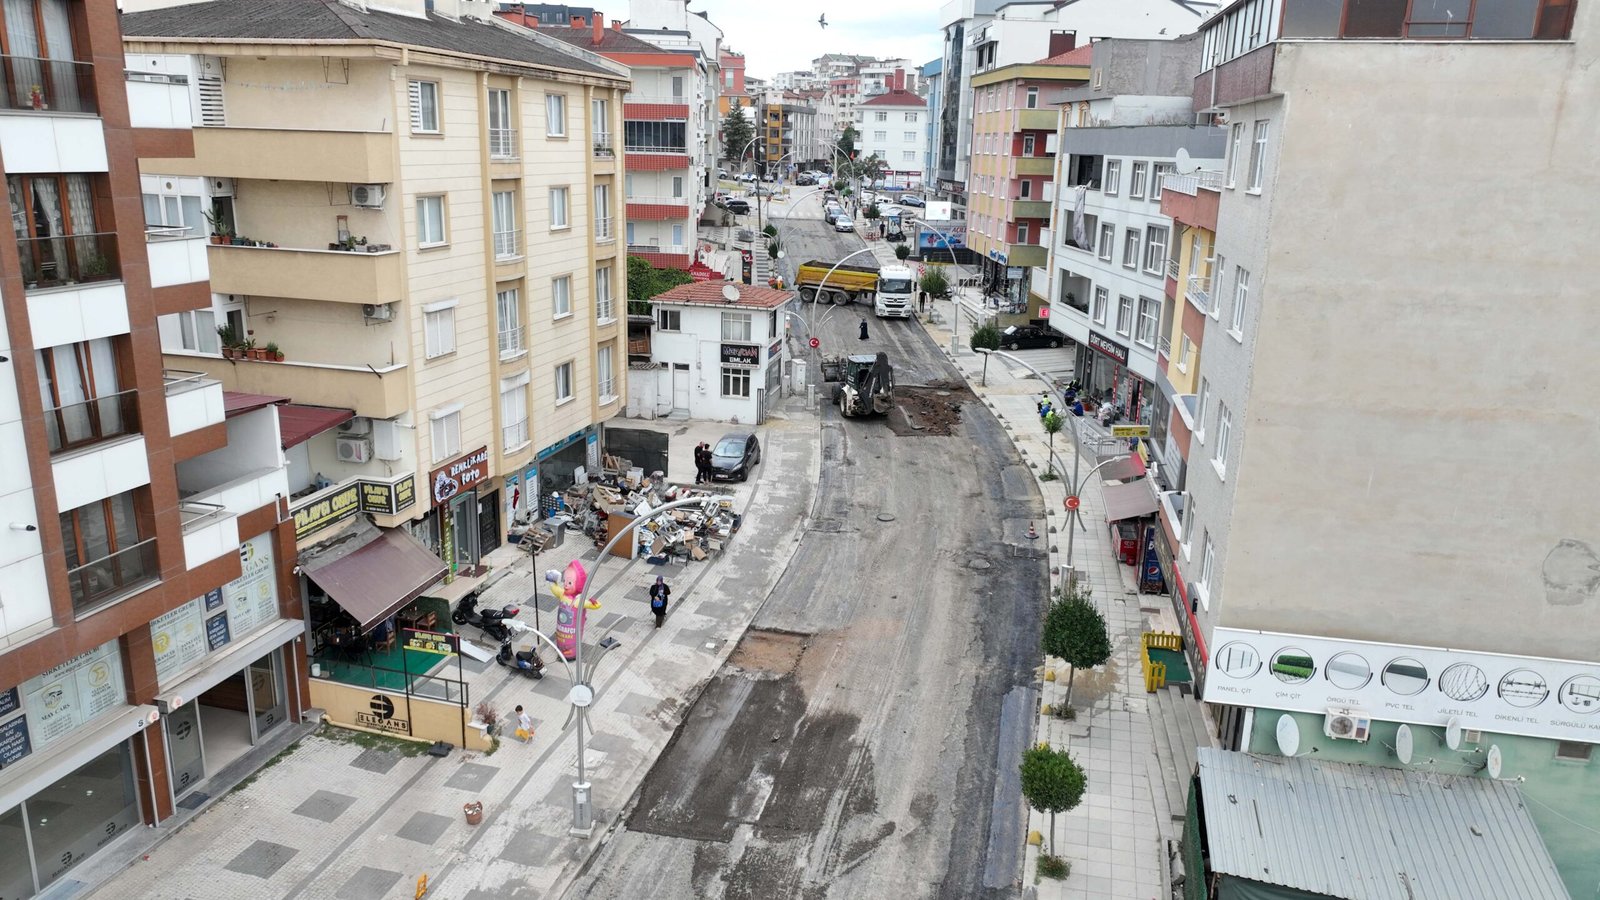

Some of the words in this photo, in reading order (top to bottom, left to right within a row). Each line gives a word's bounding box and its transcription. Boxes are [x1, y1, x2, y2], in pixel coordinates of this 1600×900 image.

[729, 356, 751, 364] EMLAK
[451, 450, 488, 477] RENKLİKARE
[461, 469, 480, 485] FOTO
[1217, 685, 1239, 693] PANEL
[1241, 687, 1252, 695] ÇİT
[1275, 690, 1288, 698] ÇİM
[1290, 692, 1301, 700] ÇİT
[1326, 695, 1347, 704] ÖRGÜ
[1437, 707, 1463, 716] JİLETLİ
[1465, 710, 1479, 718] TEL
[360, 714, 406, 729] ELEGANS
[1494, 713, 1524, 723] DİKENLİ
[1526, 716, 1540, 724] TEL
[1550, 719, 1587, 729] SÜRGÜLÜ
